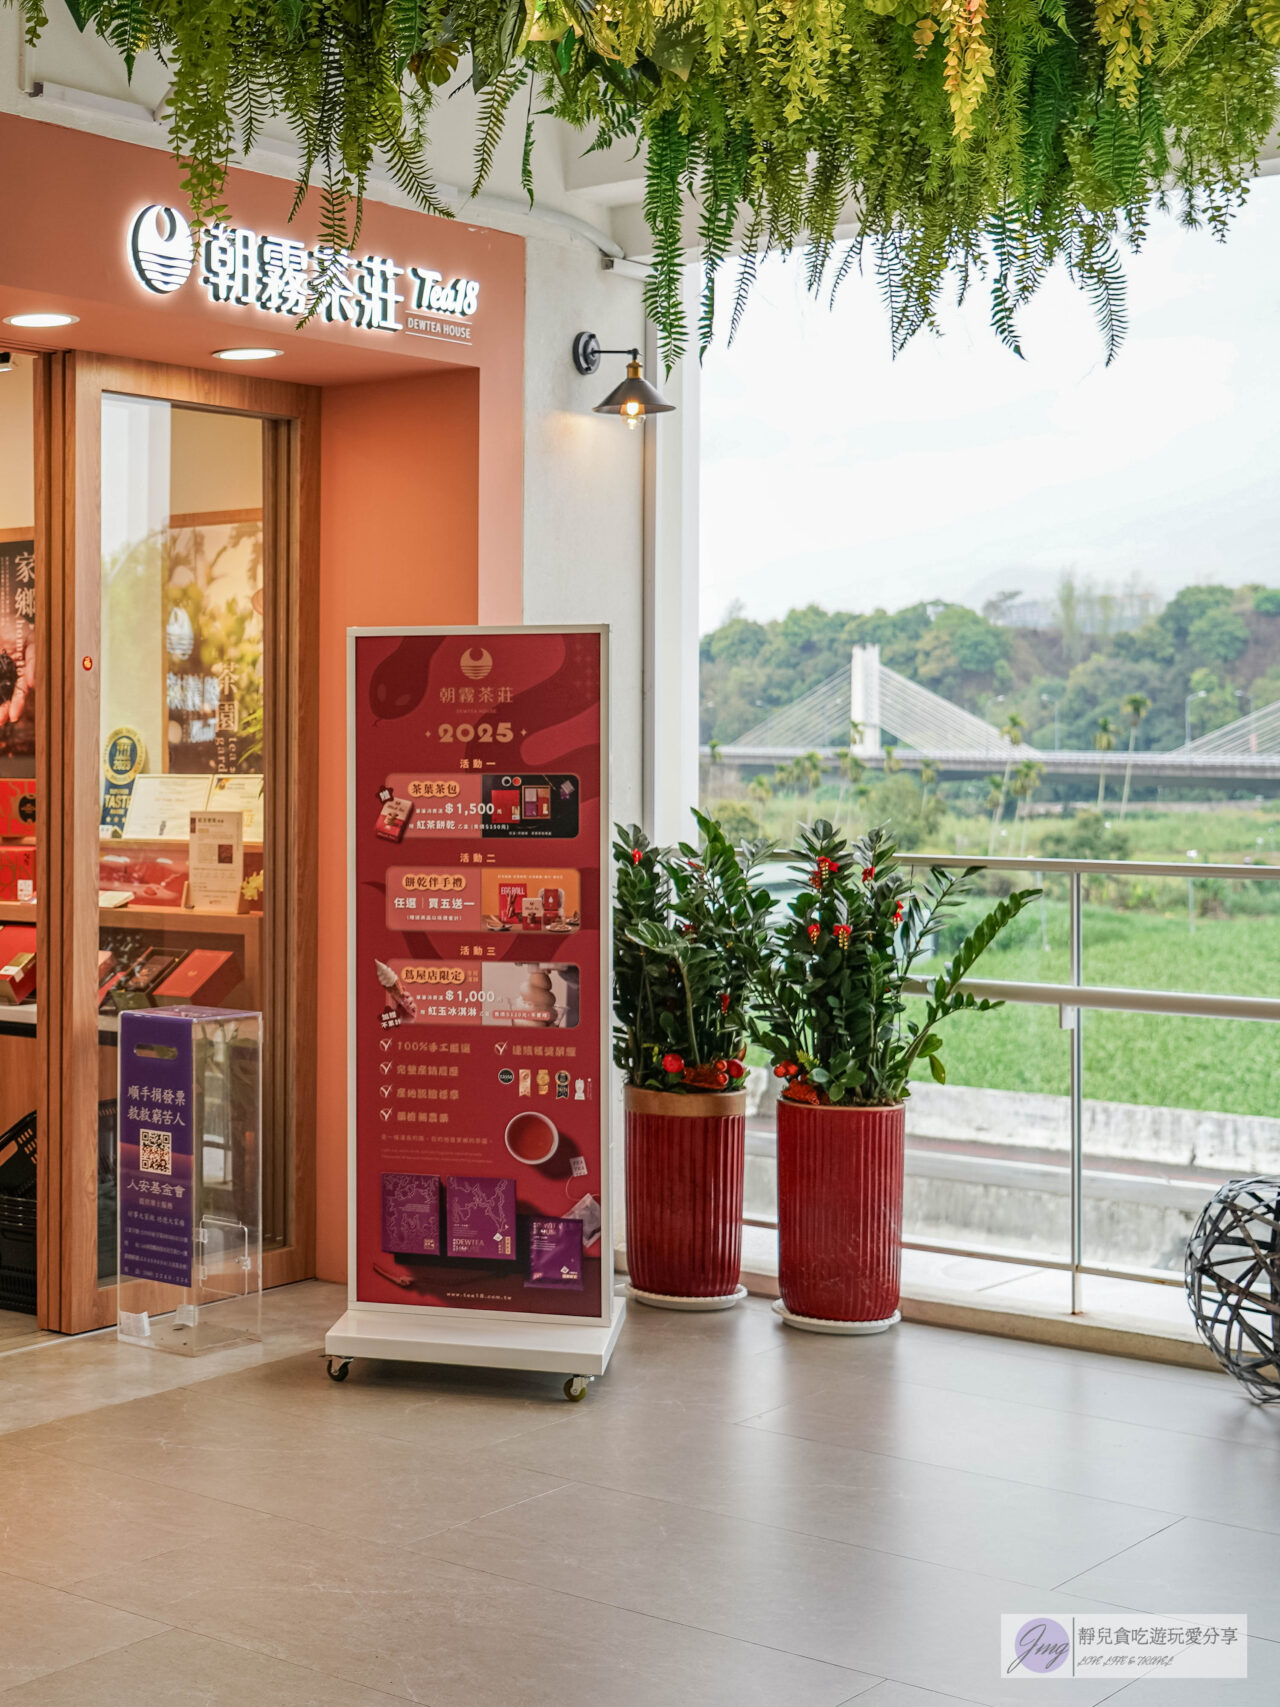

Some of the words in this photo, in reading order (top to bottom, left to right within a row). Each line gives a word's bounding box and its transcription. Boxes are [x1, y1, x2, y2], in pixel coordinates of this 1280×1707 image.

[198, 222, 405, 332] 朝霧茶莊
[408, 266, 480, 318] Tea18
[407, 317, 442, 334] DEWTEA
[443, 321, 472, 339] HOUSE
[216, 661, 240, 733] 茶園
[439, 686, 514, 704] 朝霧茶莊
[438, 722, 515, 743] 2025
[459, 758, 497, 770] 活動一
[410, 782, 458, 796] 茶葉茶包
[445, 803, 495, 817] $1,500
[416, 819, 456, 831] 紅茶餅乾
[459, 852, 497, 864] 活動二
[404, 875, 464, 889] 餅乾伴手禮
[393, 897, 417, 910] 任選
[427, 897, 476, 910] 買五送一
[459, 945, 497, 957] 活動三
[404, 968, 463, 983] 蔦屋店限定
[445, 989, 495, 1005] $1,000
[427, 1005, 477, 1018] 紅玉冰淇淋
[127, 1084, 186, 1107] 順手捐發票
[127, 1106, 186, 1126] 救救窮苦人
[126, 1179, 186, 1199] 人安基金會
